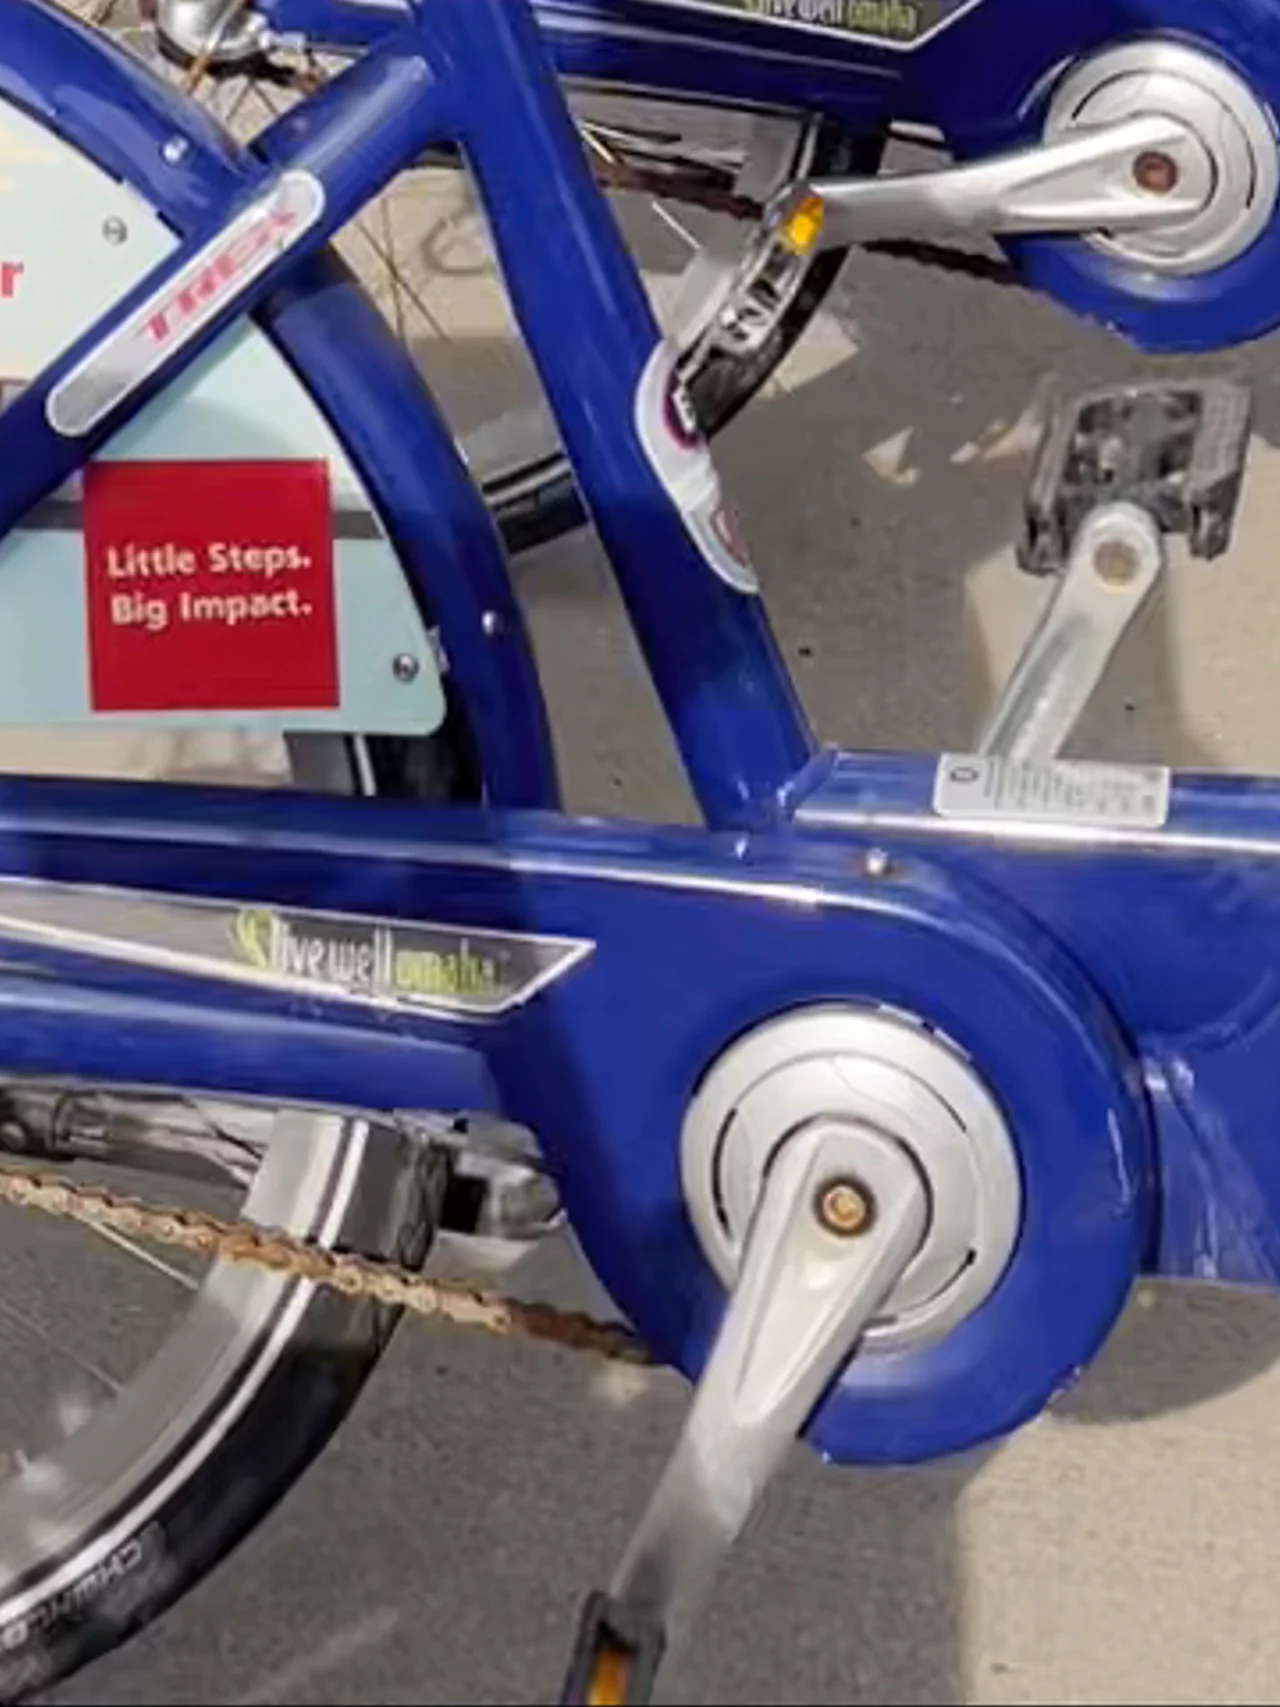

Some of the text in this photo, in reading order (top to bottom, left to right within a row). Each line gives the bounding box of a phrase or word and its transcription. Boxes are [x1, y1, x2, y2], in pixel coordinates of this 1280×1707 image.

[106, 541, 312, 579] Little Steps.
[111, 589, 312, 633] Big Impact.
